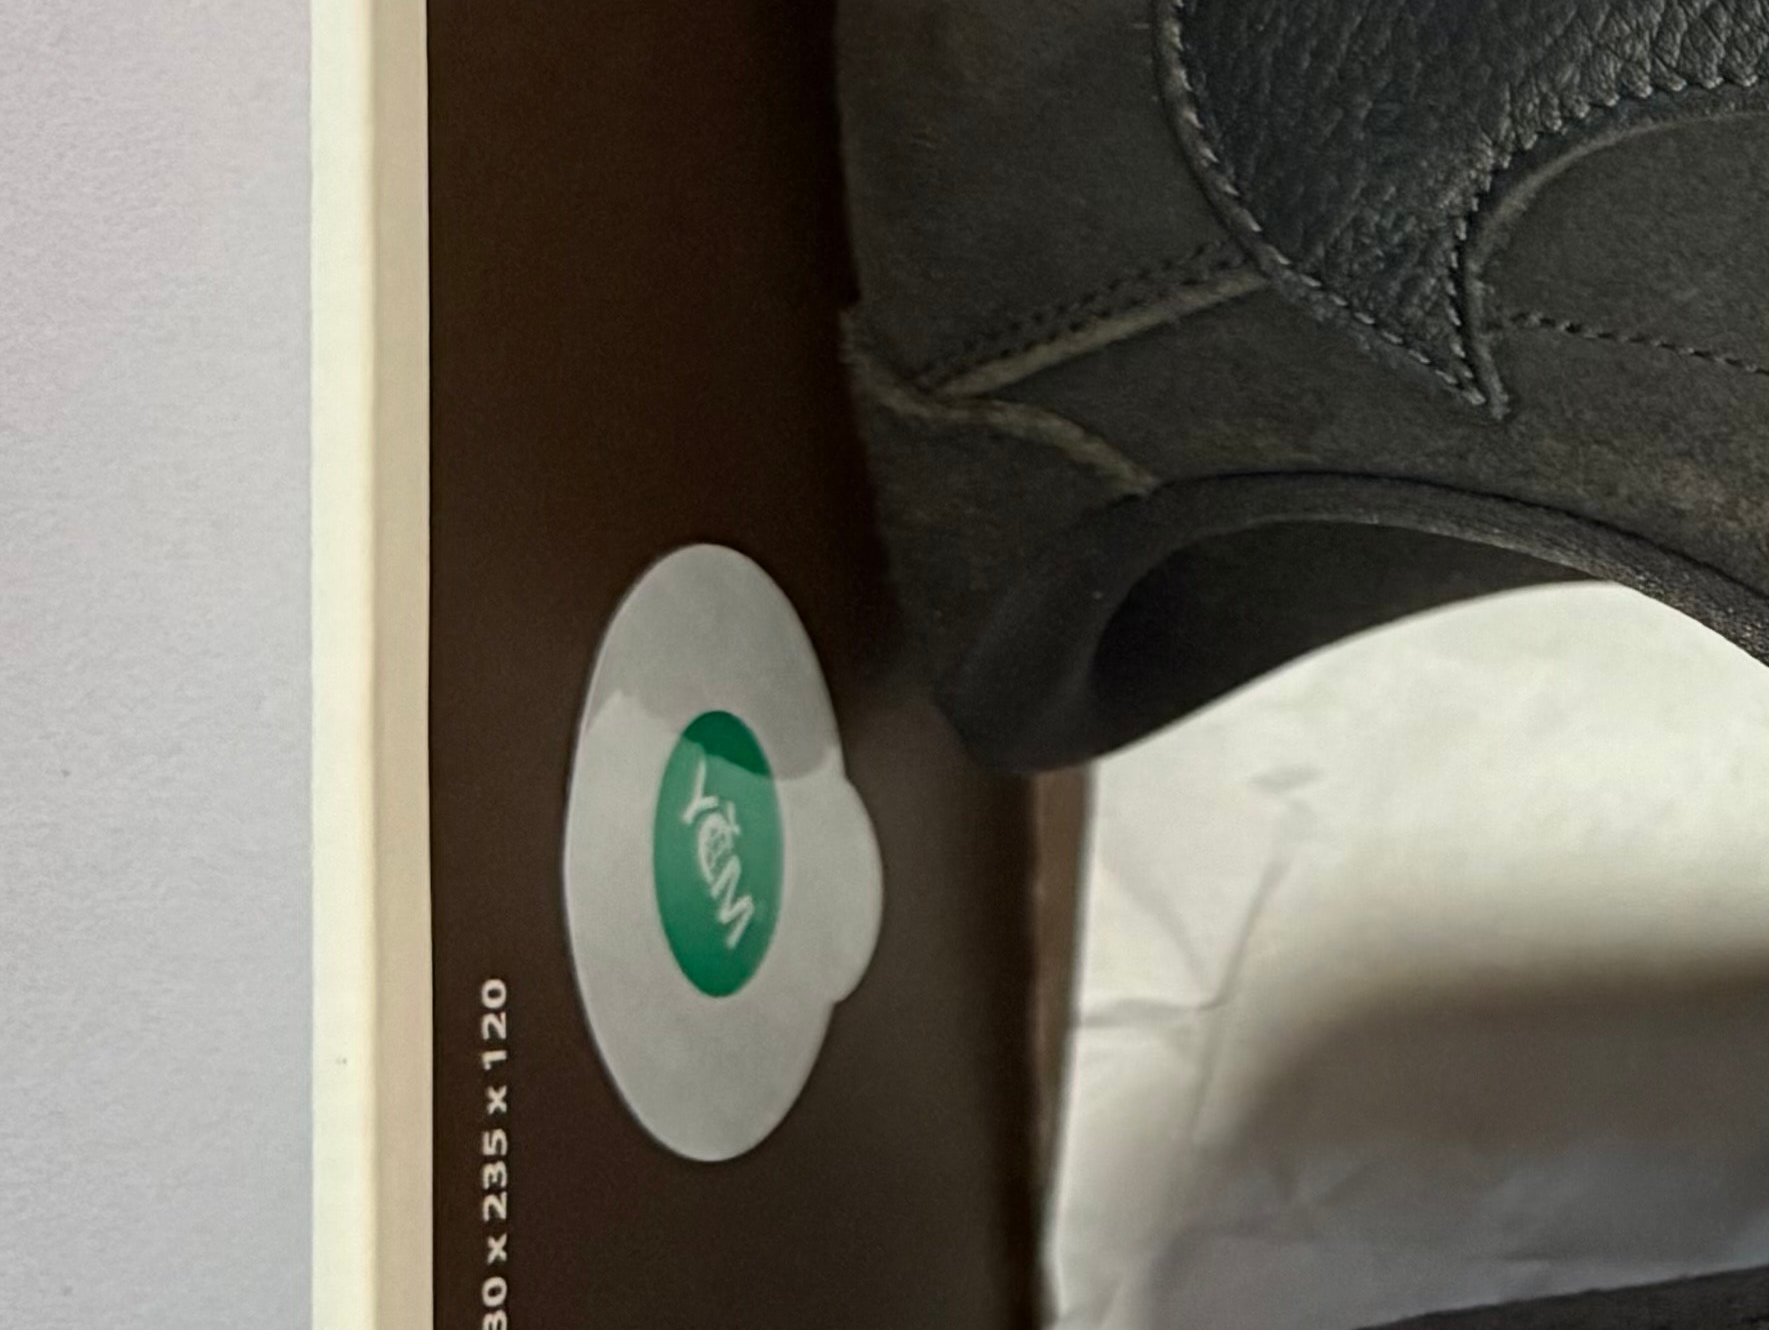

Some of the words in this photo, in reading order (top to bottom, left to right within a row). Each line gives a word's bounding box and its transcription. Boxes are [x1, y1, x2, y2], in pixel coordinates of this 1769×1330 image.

[481, 978, 508, 1070] 120
[486, 1084, 508, 1115] x
[482, 1127, 508, 1222] 235
[486, 1232, 508, 1265] x
